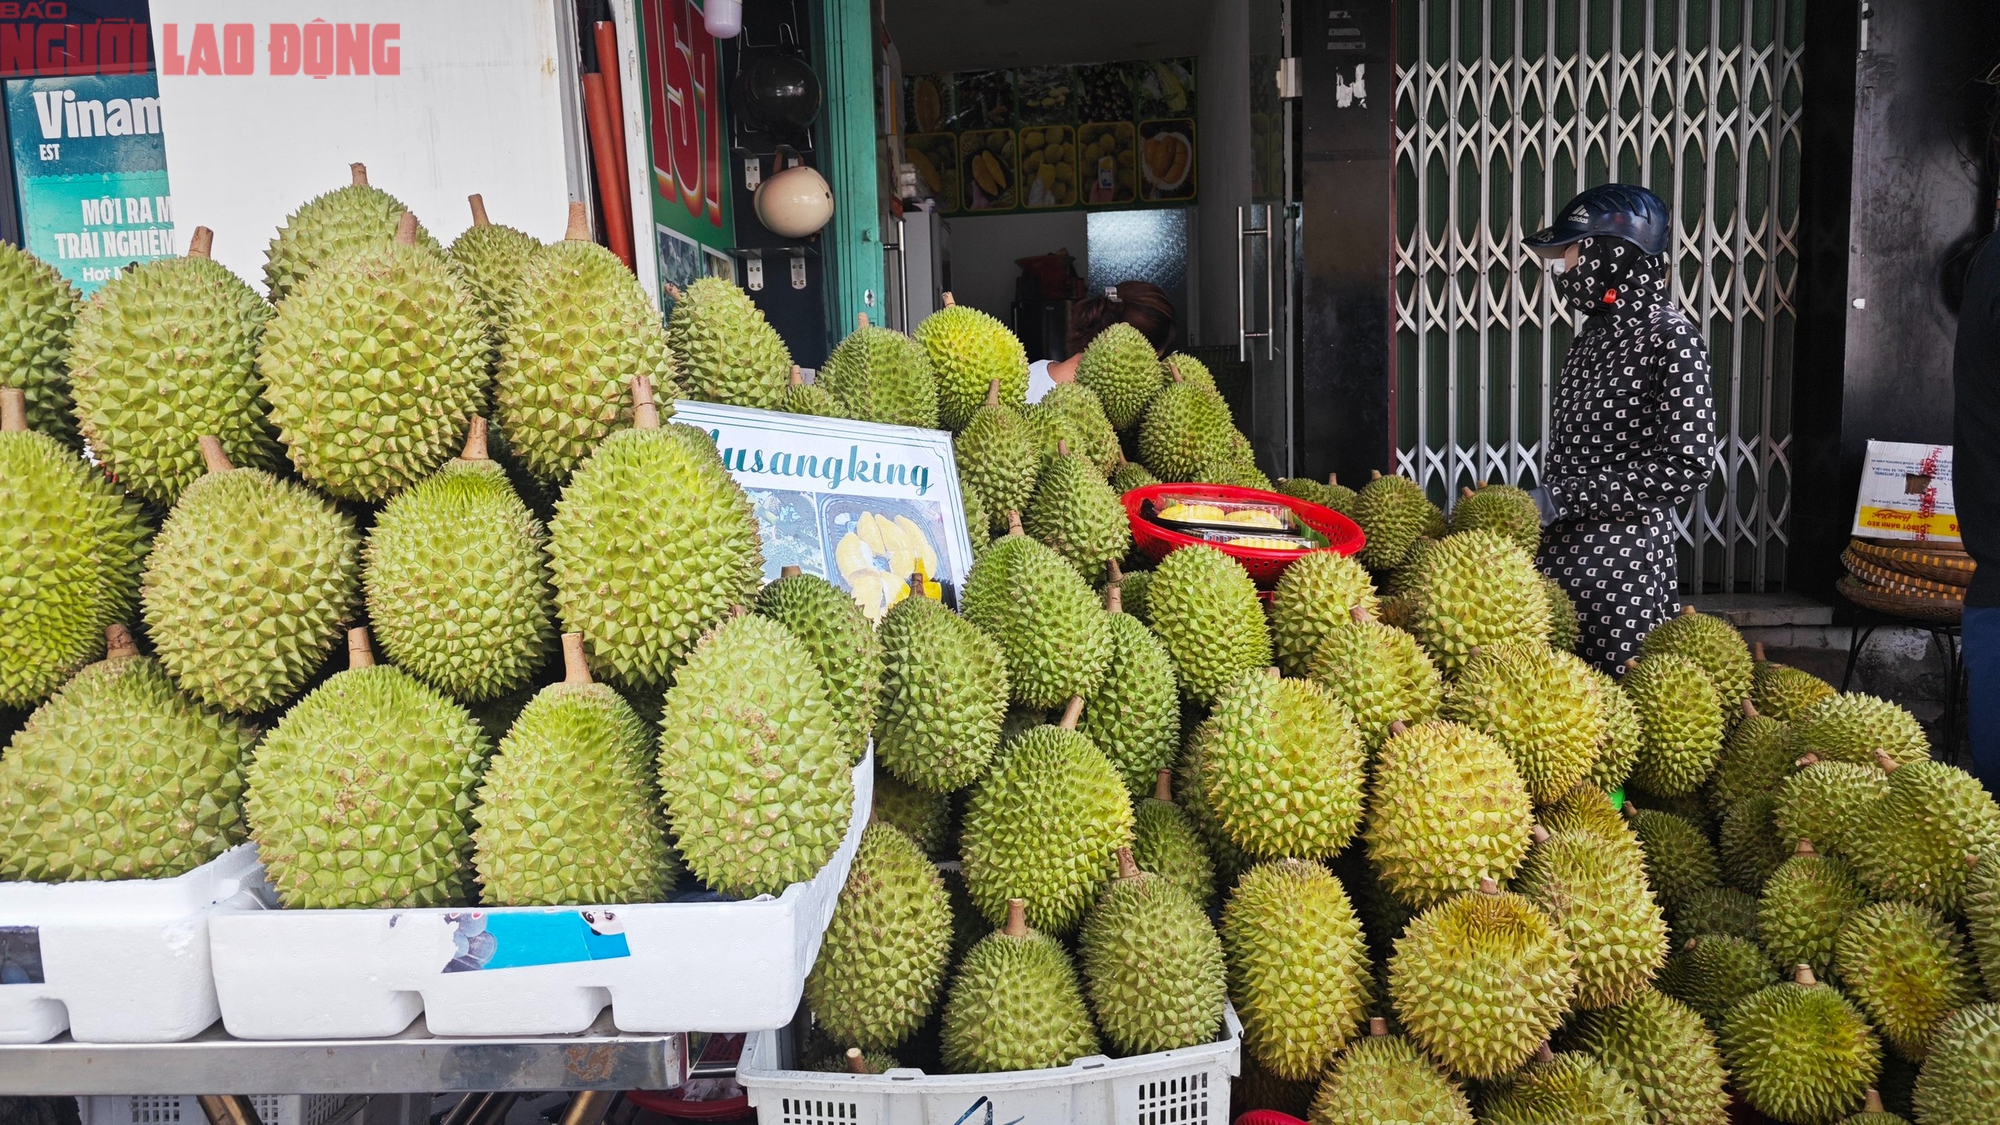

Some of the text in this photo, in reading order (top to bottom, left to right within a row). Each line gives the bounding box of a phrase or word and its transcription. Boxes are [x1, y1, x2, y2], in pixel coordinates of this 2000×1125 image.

[640, 0, 722, 220] 157
[39, 143, 60, 161] EST
[81, 196, 123, 226] MỚI
[125, 197, 154, 224] RA
[1567, 215, 1588, 224] adidas
[54, 225, 176, 260] TRẢI NGHIỆM
[82, 267, 111, 282] Hot
[709, 428, 935, 497] usangking
